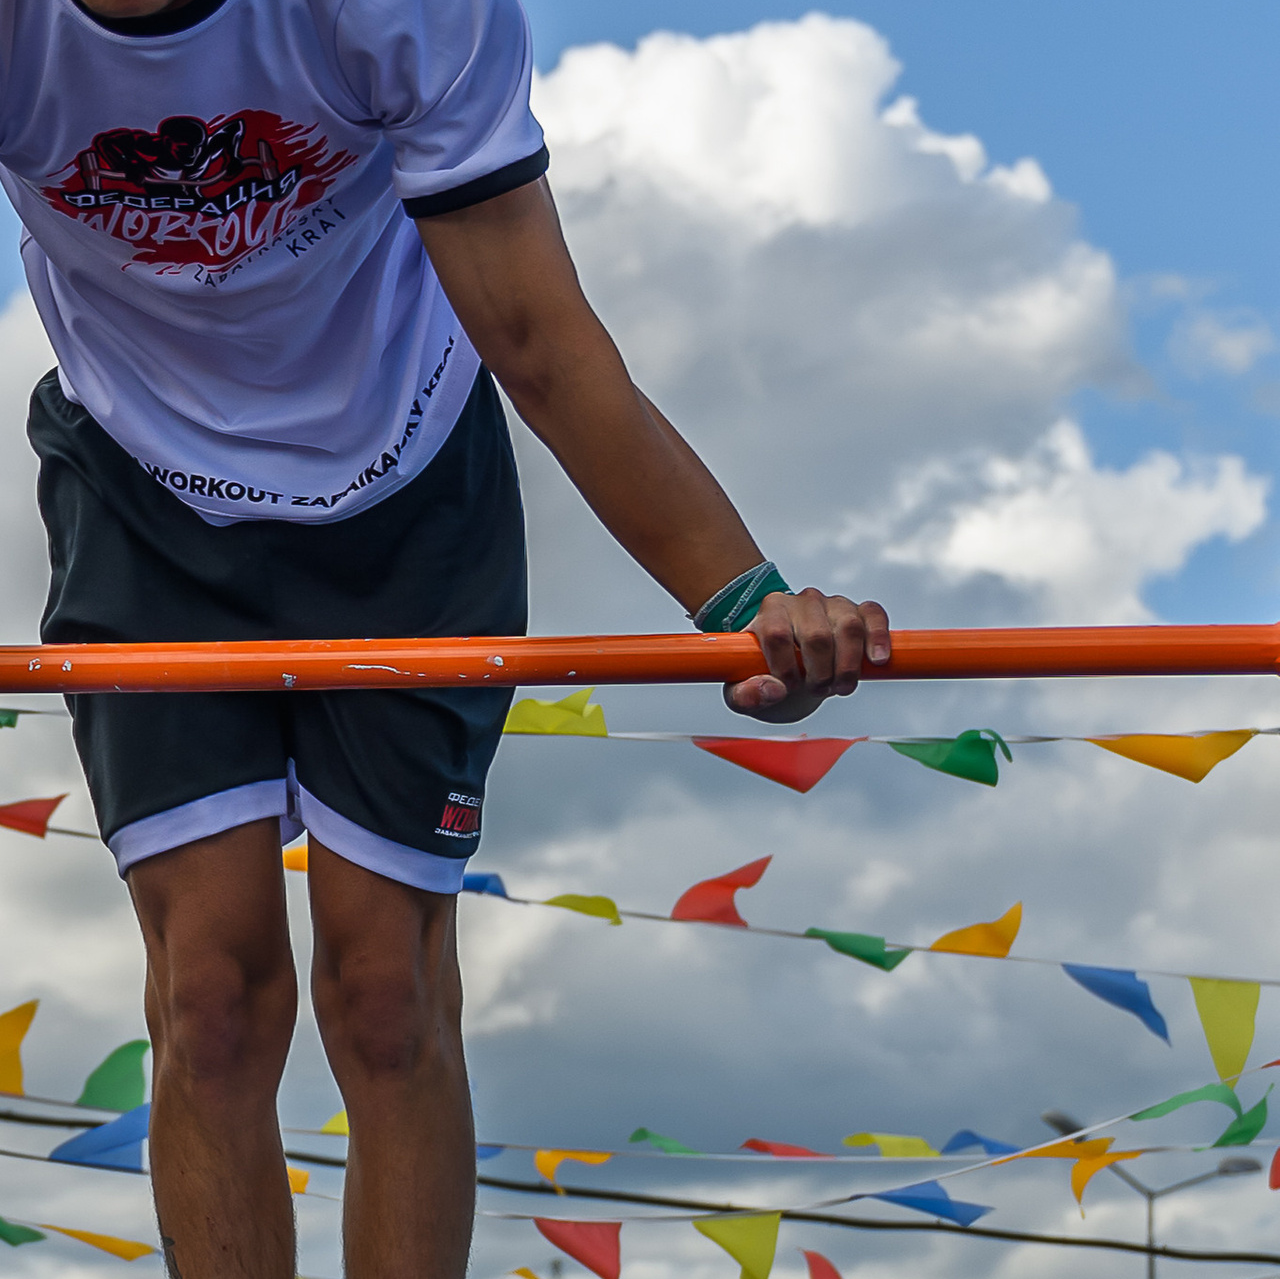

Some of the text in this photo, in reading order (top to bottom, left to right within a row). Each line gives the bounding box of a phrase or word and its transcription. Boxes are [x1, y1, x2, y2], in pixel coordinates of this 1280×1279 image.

[65, 169, 297, 215] ФЕДЕРАЦИЯ
[76, 197, 299, 257] WORKOUT
[285, 208, 347, 258] KRAI
[144, 461, 284, 505] WORKOUT
